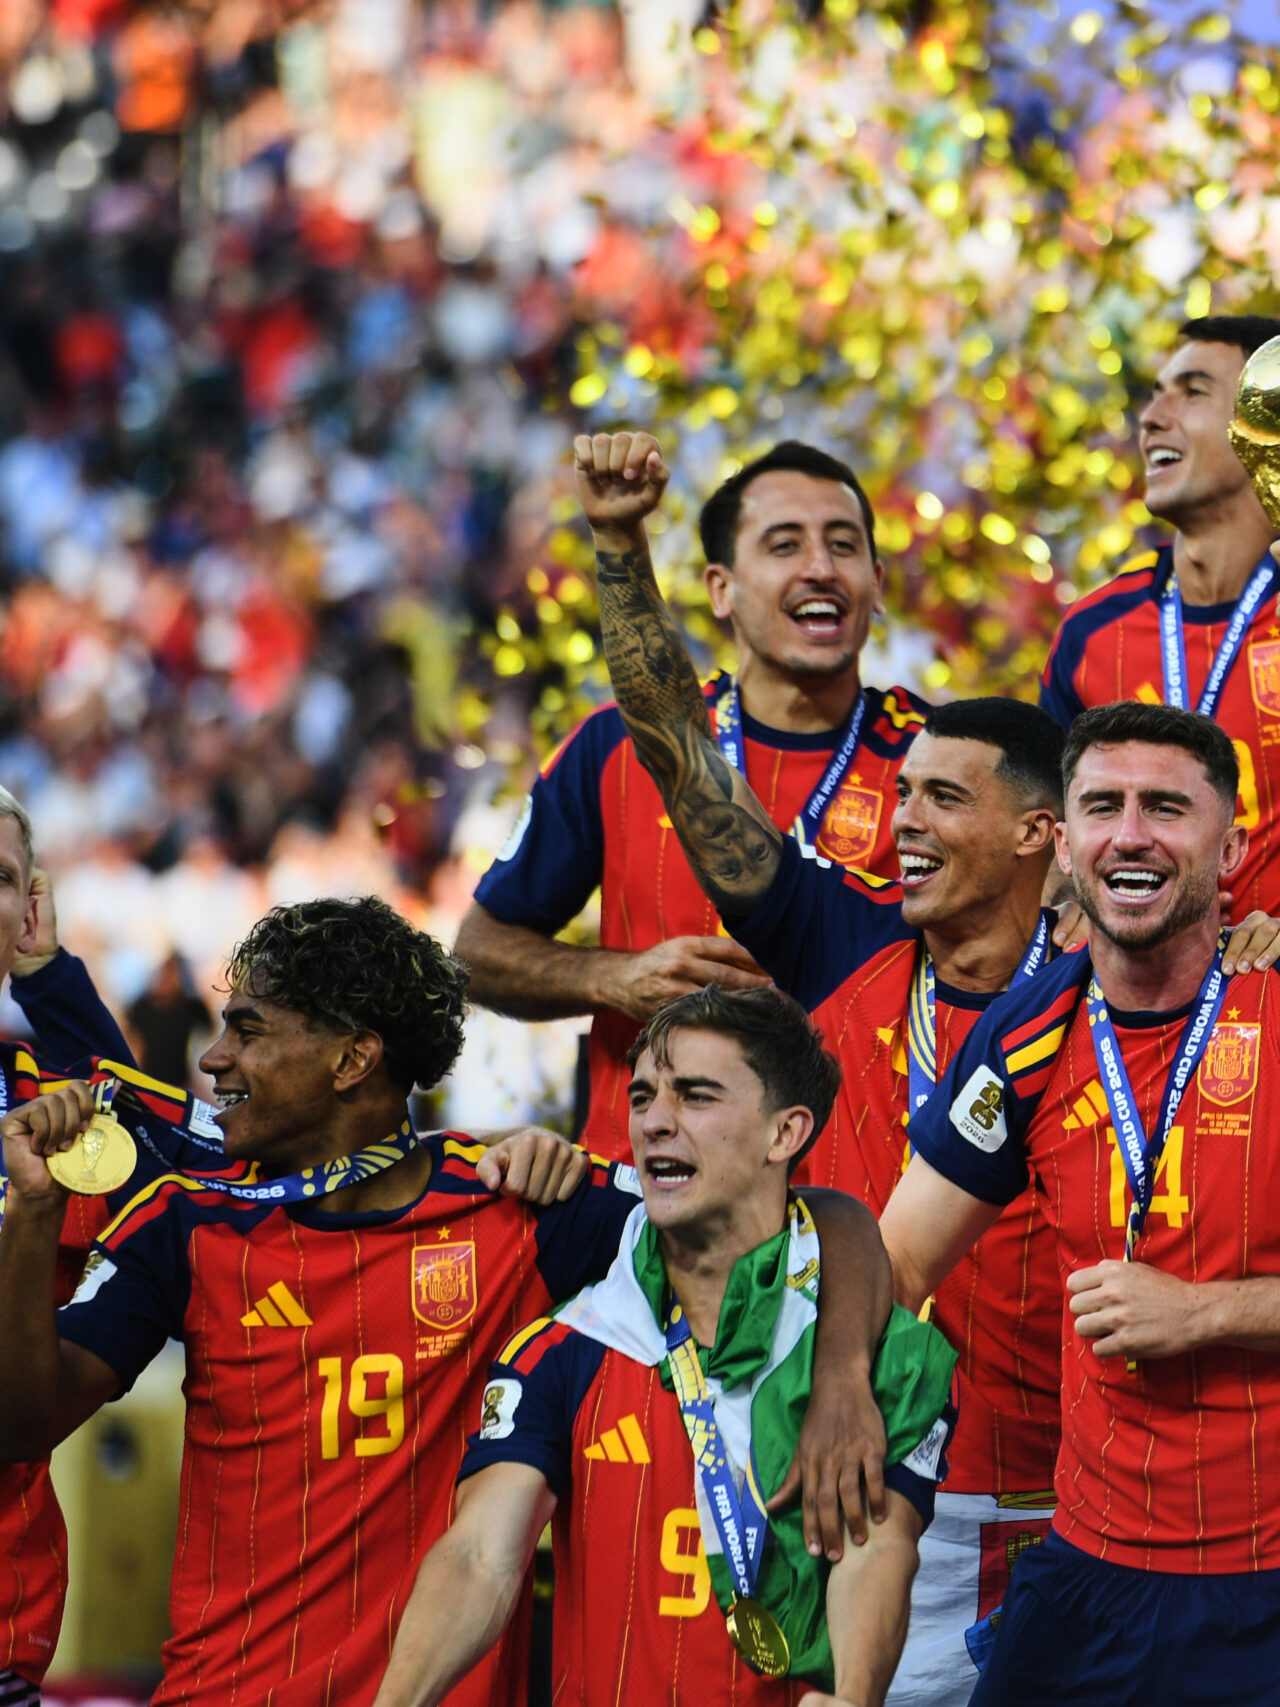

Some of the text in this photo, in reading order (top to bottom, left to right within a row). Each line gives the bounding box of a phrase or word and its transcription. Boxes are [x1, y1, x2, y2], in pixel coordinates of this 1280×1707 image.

[1208, 644, 1235, 692] WORLD
[1226, 613, 1245, 645] CUP
[1239, 567, 1274, 615] 2026
[1166, 637, 1181, 686] WORLD
[807, 794, 827, 820] FIFA
[821, 755, 848, 797] WORLD
[843, 734, 857, 757] CUP
[1023, 947, 1044, 977] FIFA
[1205, 969, 1223, 1001] FIFA
[1184, 1001, 1215, 1057] WORLD
[1100, 1036, 1123, 1090] 2026
[1173, 1057, 1192, 1089] CUP
[1112, 1091, 1131, 1122] CUP
[1106, 1125, 1189, 1228] 14
[1121, 1122, 1144, 1177] WORLD
[229, 1185, 285, 1199] 2026
[318, 1352, 405, 1460] 19
[713, 1484, 732, 1520] FIFA
[723, 1518, 746, 1577] WORLD
[659, 1507, 711, 1618] 9
